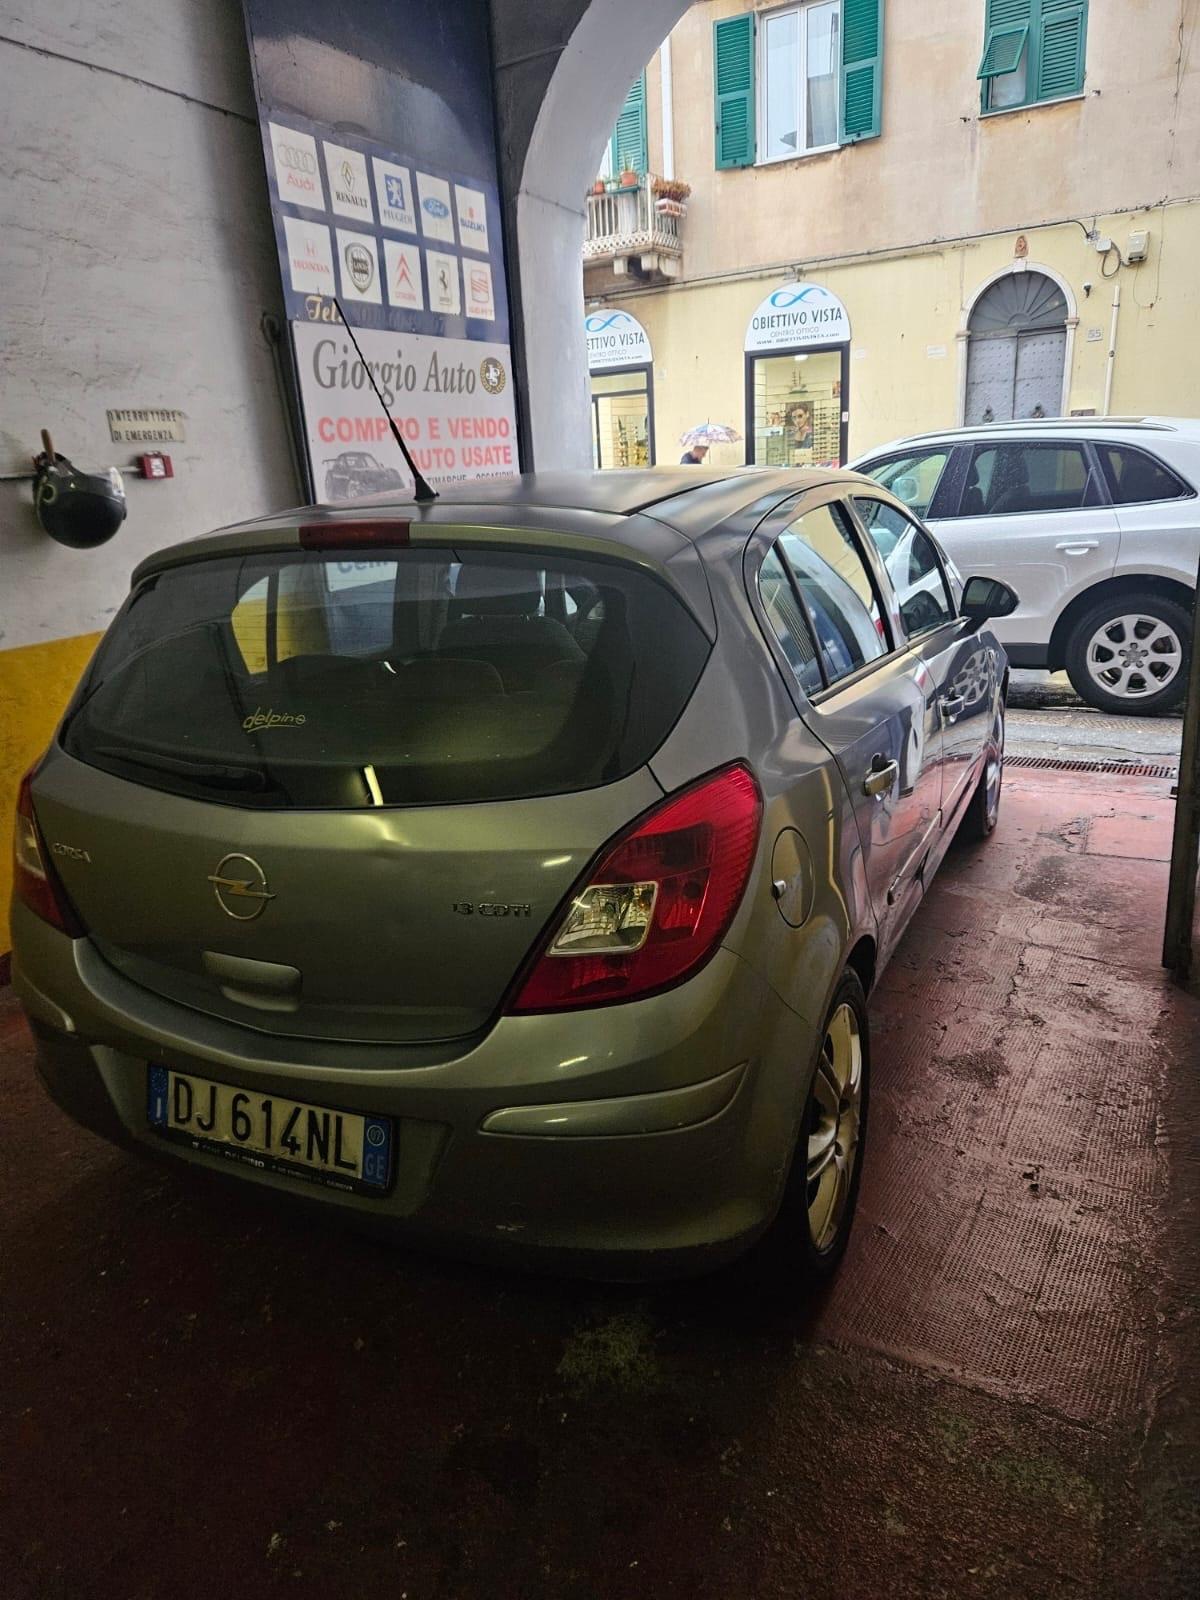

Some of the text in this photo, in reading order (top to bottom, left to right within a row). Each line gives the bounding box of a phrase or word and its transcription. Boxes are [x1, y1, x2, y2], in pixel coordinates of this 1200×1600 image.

[336, 191, 368, 209] RENAULT
[753, 307, 842, 330] OBIETTIVO VISTA
[619, 332, 645, 346] VISTA
[770, 326, 819, 338] CENTRO OTTICO
[313, 339, 476, 407] Giorgio Auto
[125, 429, 174, 441] EMERGENZA
[428, 418, 440, 440] E
[449, 417, 510, 439] VENDO
[462, 446, 512, 468] USATE
[365, 1152, 386, 1180] GE
